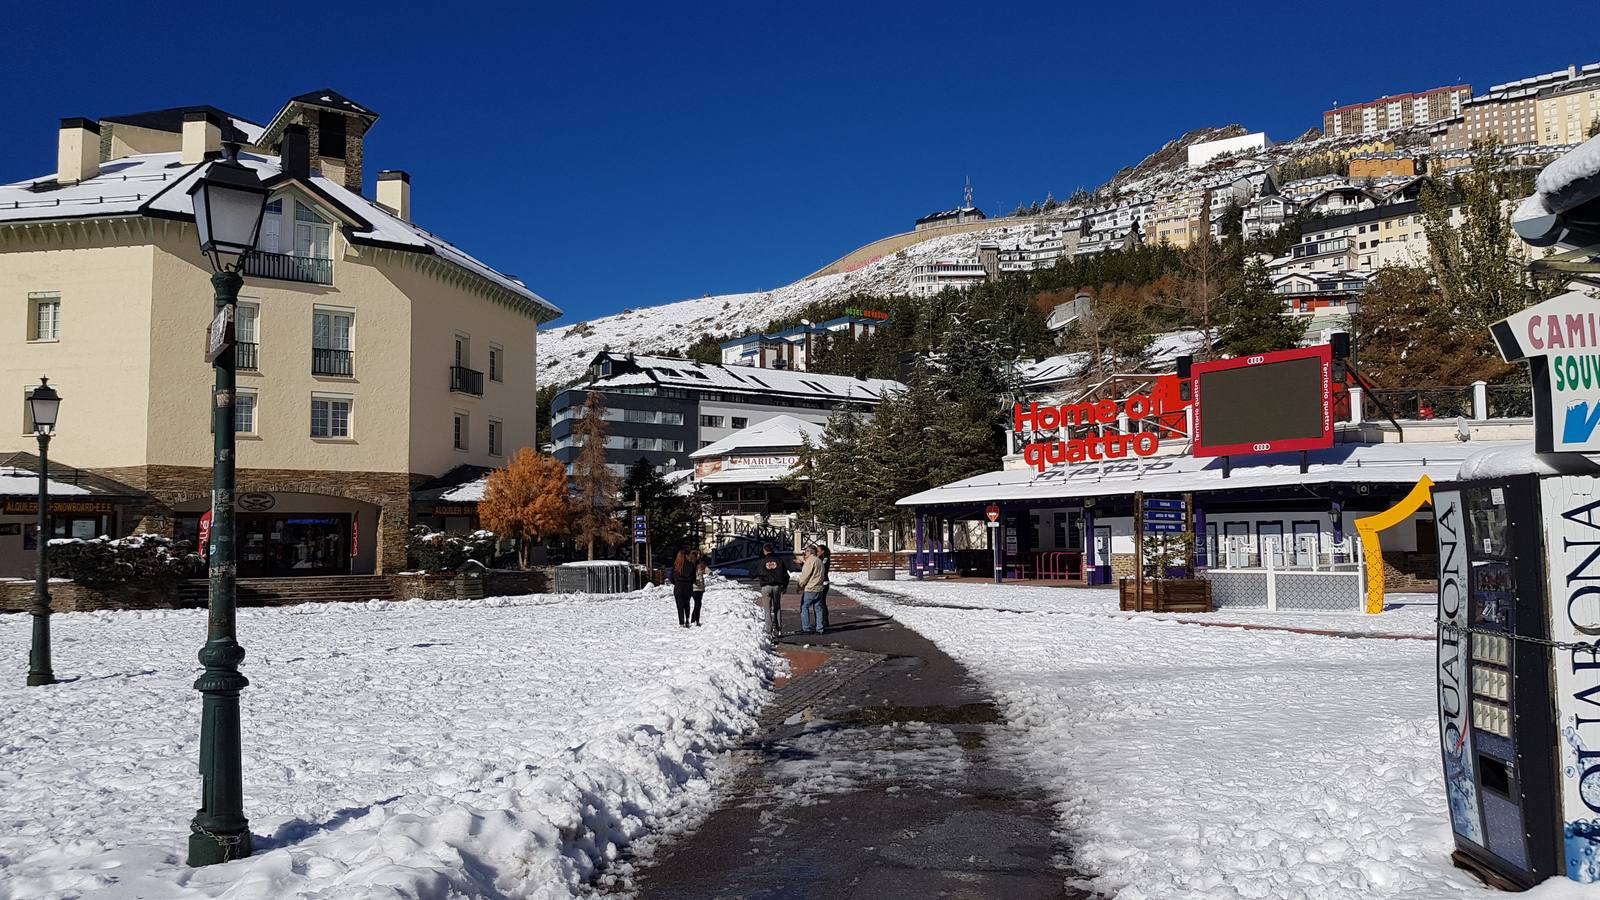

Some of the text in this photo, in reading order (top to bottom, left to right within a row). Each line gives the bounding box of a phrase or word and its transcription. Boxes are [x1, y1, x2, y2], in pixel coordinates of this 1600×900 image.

[1528, 313, 1600, 350] CAMI
[1014, 383, 1166, 432] Home of
[1024, 432, 1159, 472] quattro
[1438, 502, 1472, 810] AQUABONA
